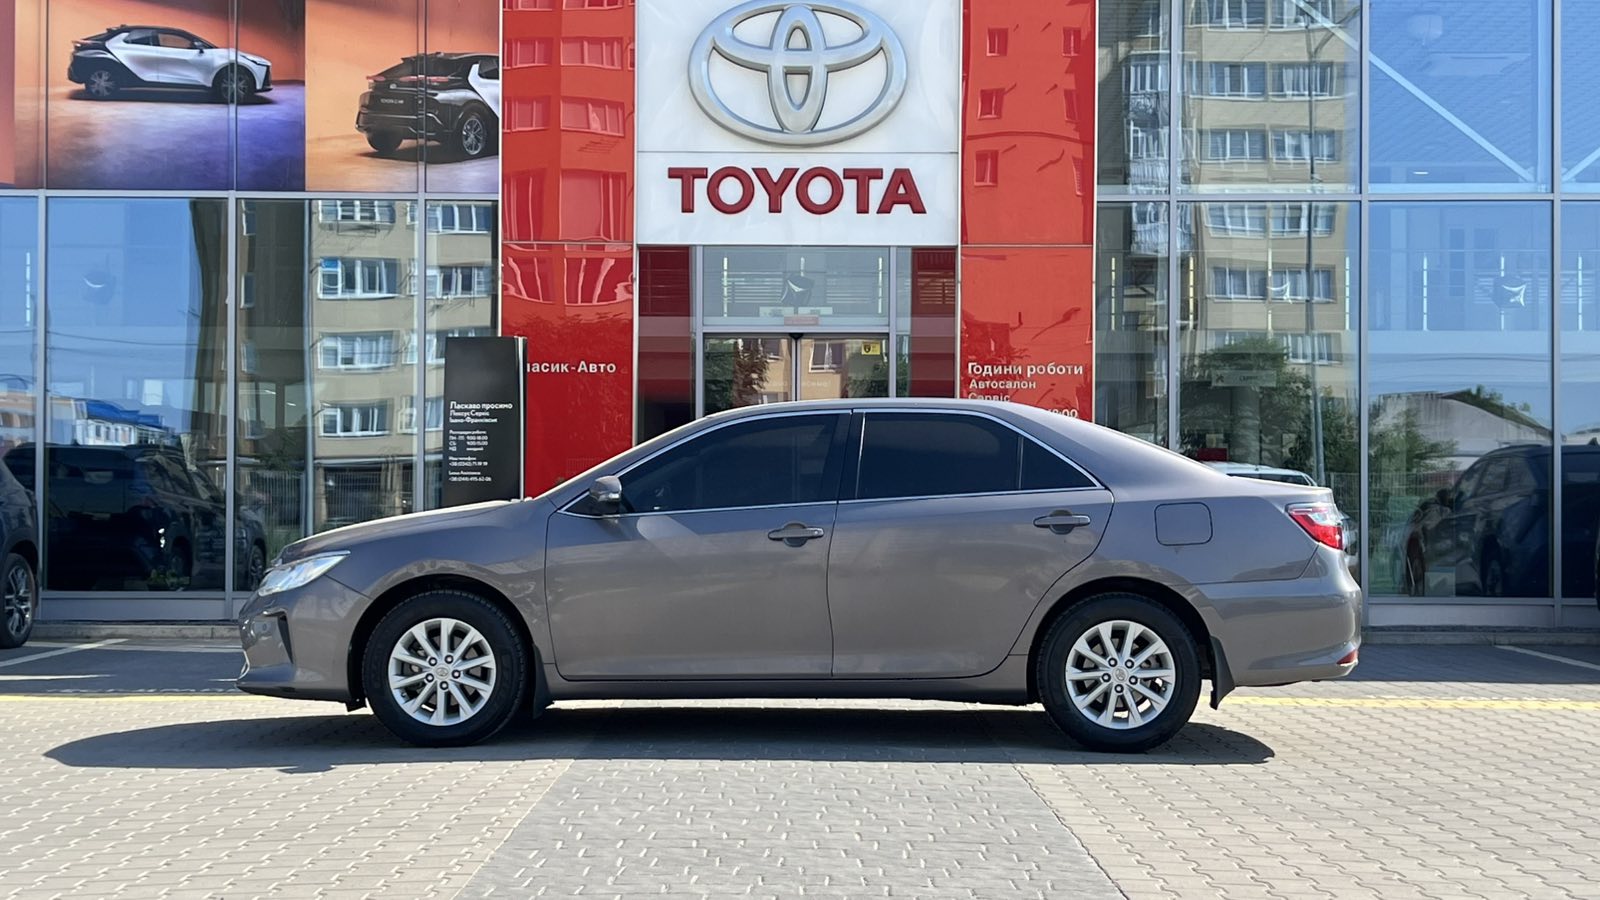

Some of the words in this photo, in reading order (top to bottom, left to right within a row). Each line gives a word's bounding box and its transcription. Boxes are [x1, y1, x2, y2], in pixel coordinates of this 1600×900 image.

[668, 166, 926, 215] TOYOTA
[968, 362, 1022, 376] Години
[1027, 362, 1083, 377] роботи
[969, 379, 1036, 389] Автосалон
